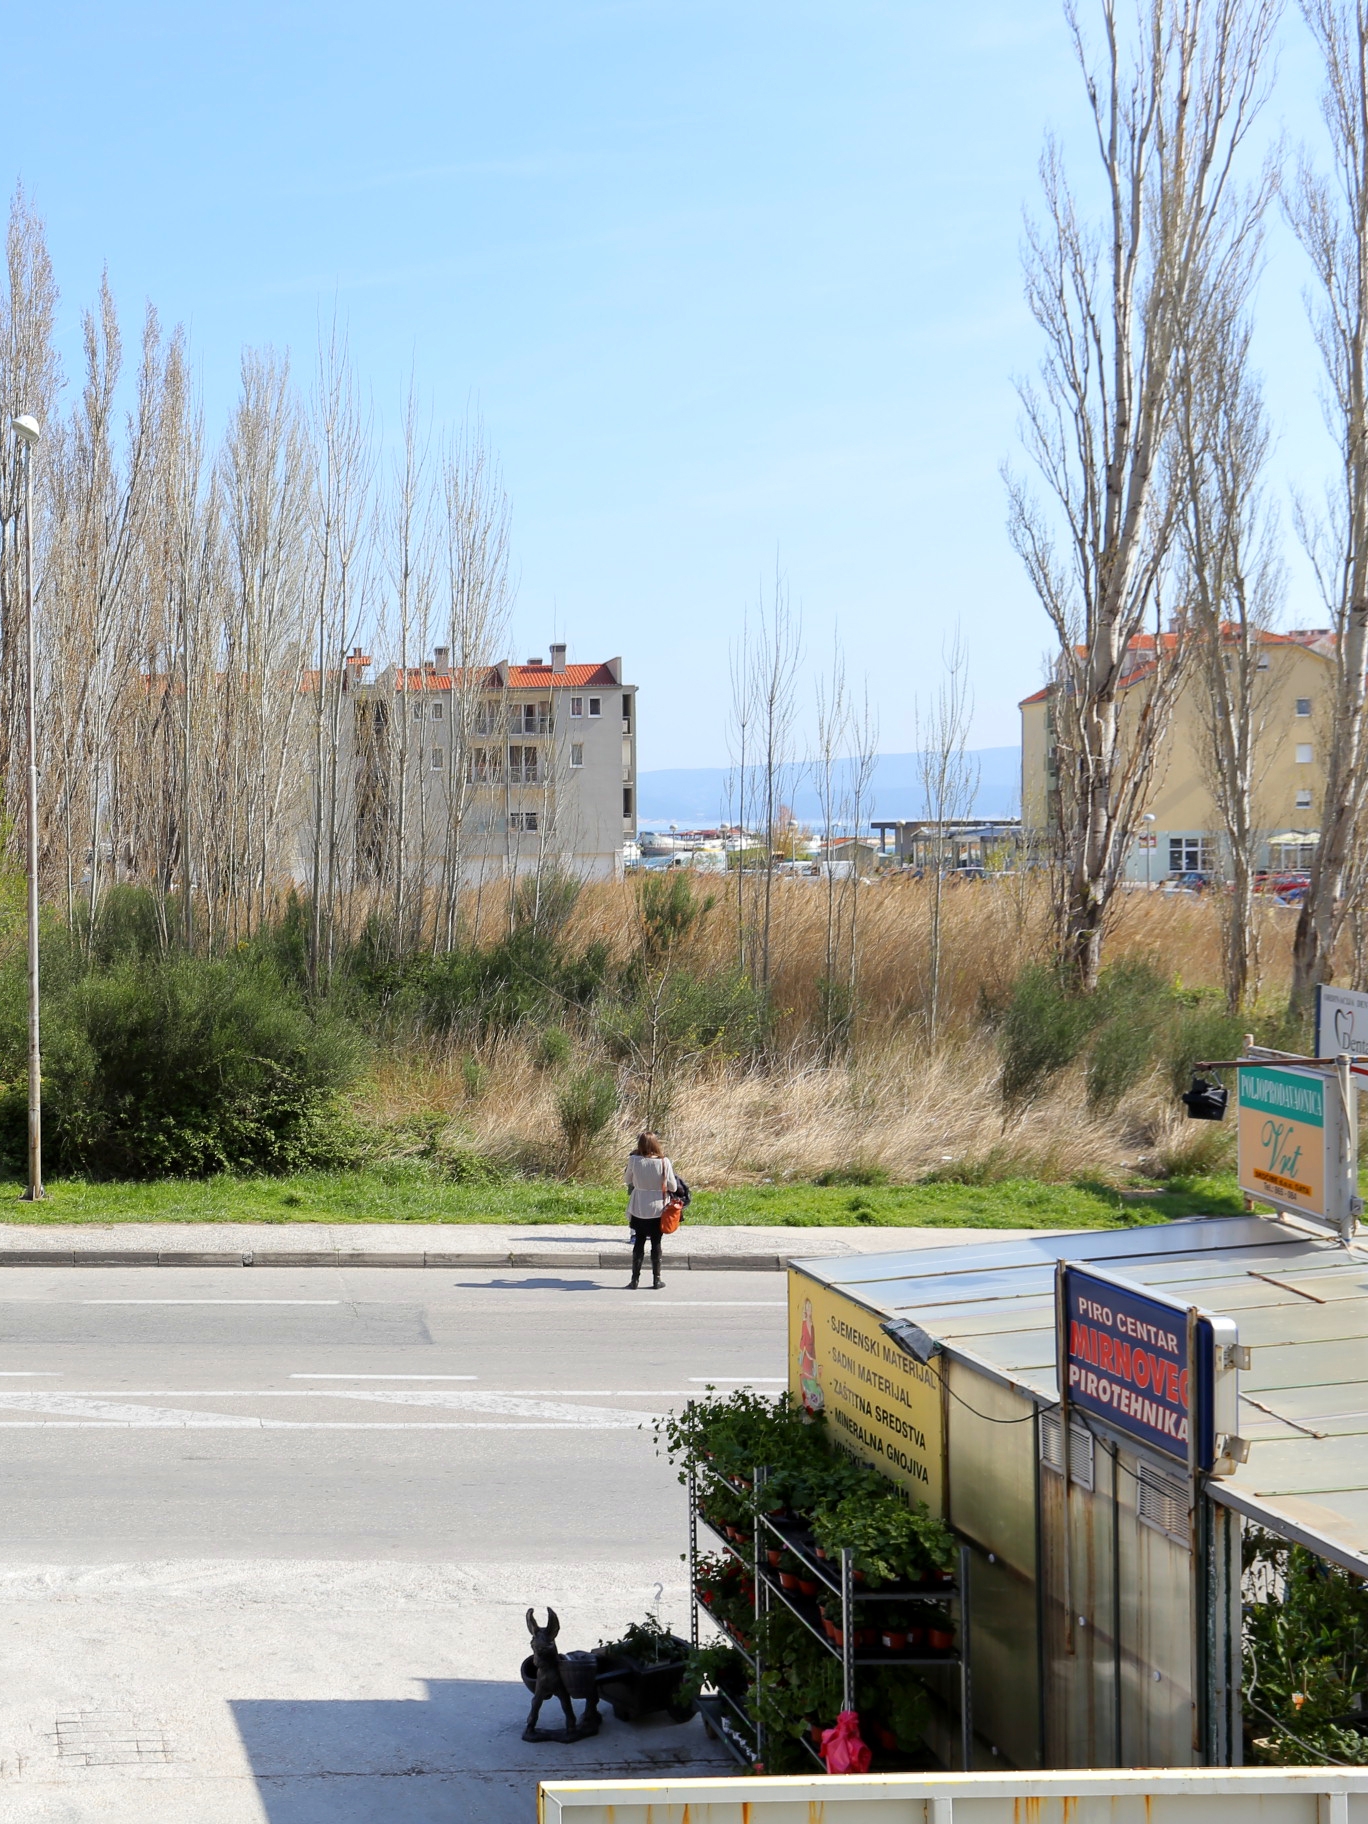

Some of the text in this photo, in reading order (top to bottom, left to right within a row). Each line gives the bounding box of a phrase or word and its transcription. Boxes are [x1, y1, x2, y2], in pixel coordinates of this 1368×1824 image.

[1261, 1120, 1303, 1178] Vrt
[831, 1315, 936, 1390] SJEMENSKI MATERIJAL
[1078, 1297, 1179, 1354] PIRO CENTAR
[832, 1347, 913, 1409] SADNI MATERIJAL
[1068, 1363, 1189, 1443] PIROTEHNIKA
[834, 1408, 929, 1485] MINERALNA GNOJIVA
[875, 1405, 926, 1451] SREDSTVA
